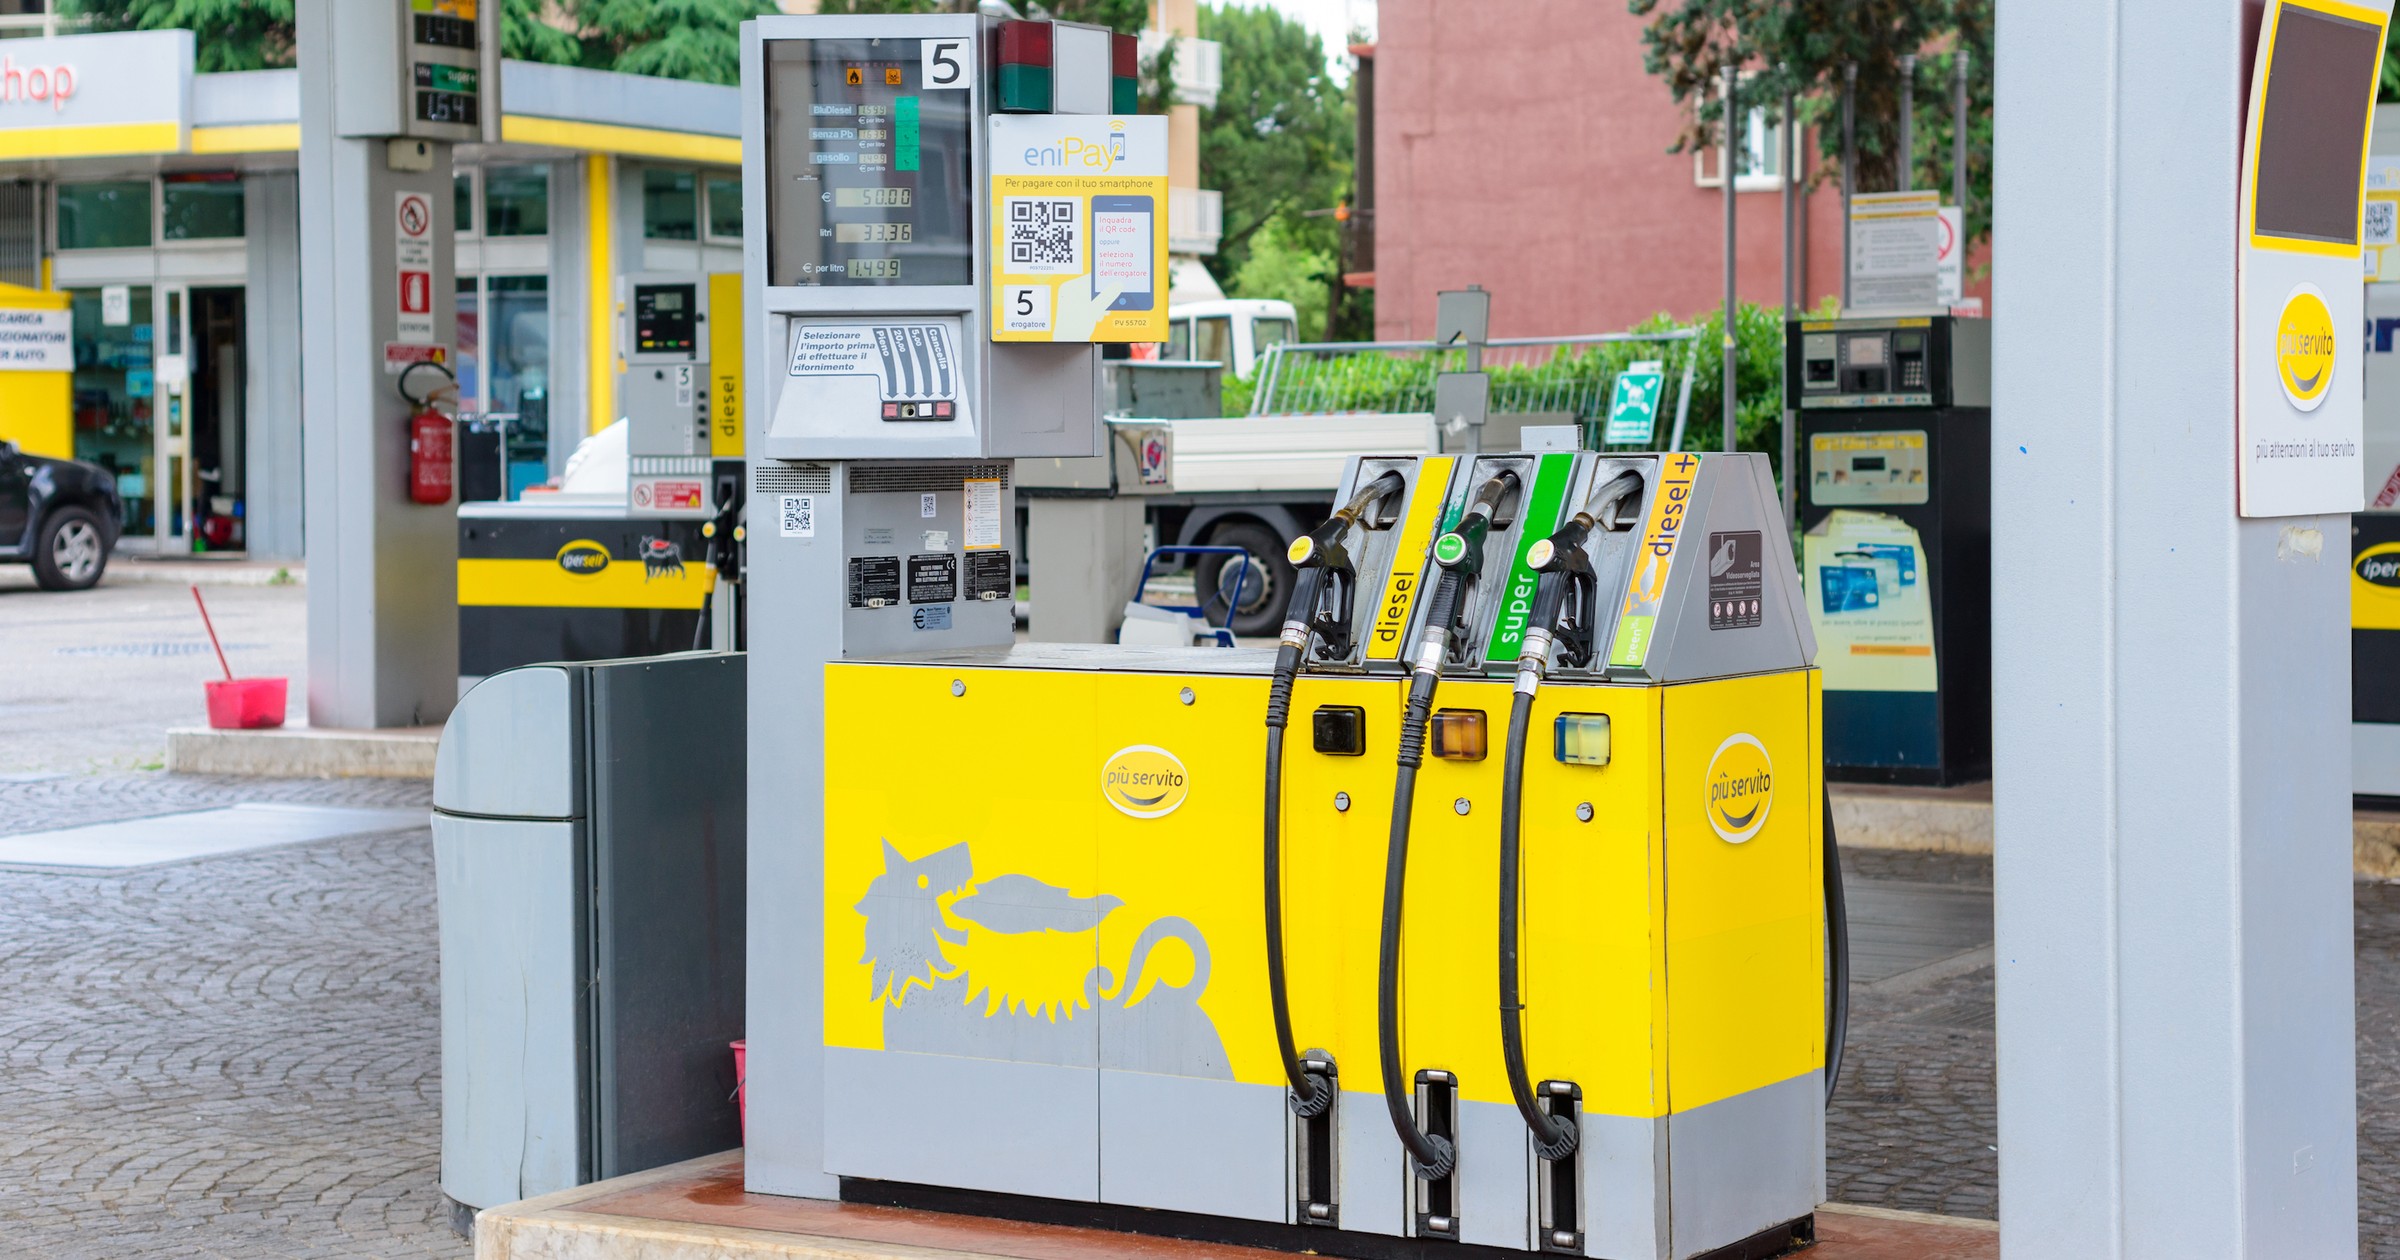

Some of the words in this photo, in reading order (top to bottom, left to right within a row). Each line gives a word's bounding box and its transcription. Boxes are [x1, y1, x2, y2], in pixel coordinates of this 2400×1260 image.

[932, 43, 961, 84] 5
[813, 106, 852, 115] BluDiesel
[812, 131, 839, 139] senza
[840, 130, 854, 139] Pb
[816, 154, 850, 163] gasolio
[1024, 137, 1121, 172] eniPay
[1005, 178, 1021, 188] Per
[1022, 180, 1053, 189] pagare
[1056, 180, 1073, 188] con
[1075, 178, 1080, 187] il
[1082, 179, 1097, 188] tuo
[1099, 178, 1153, 189] smartphone
[863, 189, 911, 205] 50.00
[1099, 217, 1132, 225] Inquadra
[819, 228, 832, 237] litri
[863, 225, 911, 241] 33.36
[1105, 226, 1117, 234] QR
[815, 264, 829, 274] per
[829, 264, 845, 273] litro
[854, 261, 899, 277] 1.499
[1017, 290, 1034, 316] 5
[1011, 321, 1046, 329] erogatore
[803, 332, 861, 340] Selezionare
[876, 330, 890, 357] Pieno
[2280, 321, 2296, 364] più
[2298, 326, 2333, 356] servito
[800, 342, 844, 351] l'importo
[846, 342, 875, 351] prima
[928, 329, 948, 370] Cancella
[809, 352, 858, 360] effettuare
[861, 352, 867, 360] il
[793, 363, 855, 371] rifornimento
[679, 367, 689, 385] 3
[720, 374, 735, 437] diesel
[2256, 438, 2268, 463] più
[2270, 438, 2307, 458] attenzioni
[2309, 438, 2316, 458] al
[2317, 441, 2330, 457] tuo
[2331, 438, 2355, 458] servito
[1376, 572, 1414, 642] diesel
[1501, 573, 1534, 643] super
[1107, 765, 1130, 788] più
[1132, 769, 1184, 787] servito
[1711, 771, 1729, 808] più
[1731, 768, 1771, 798] servito
